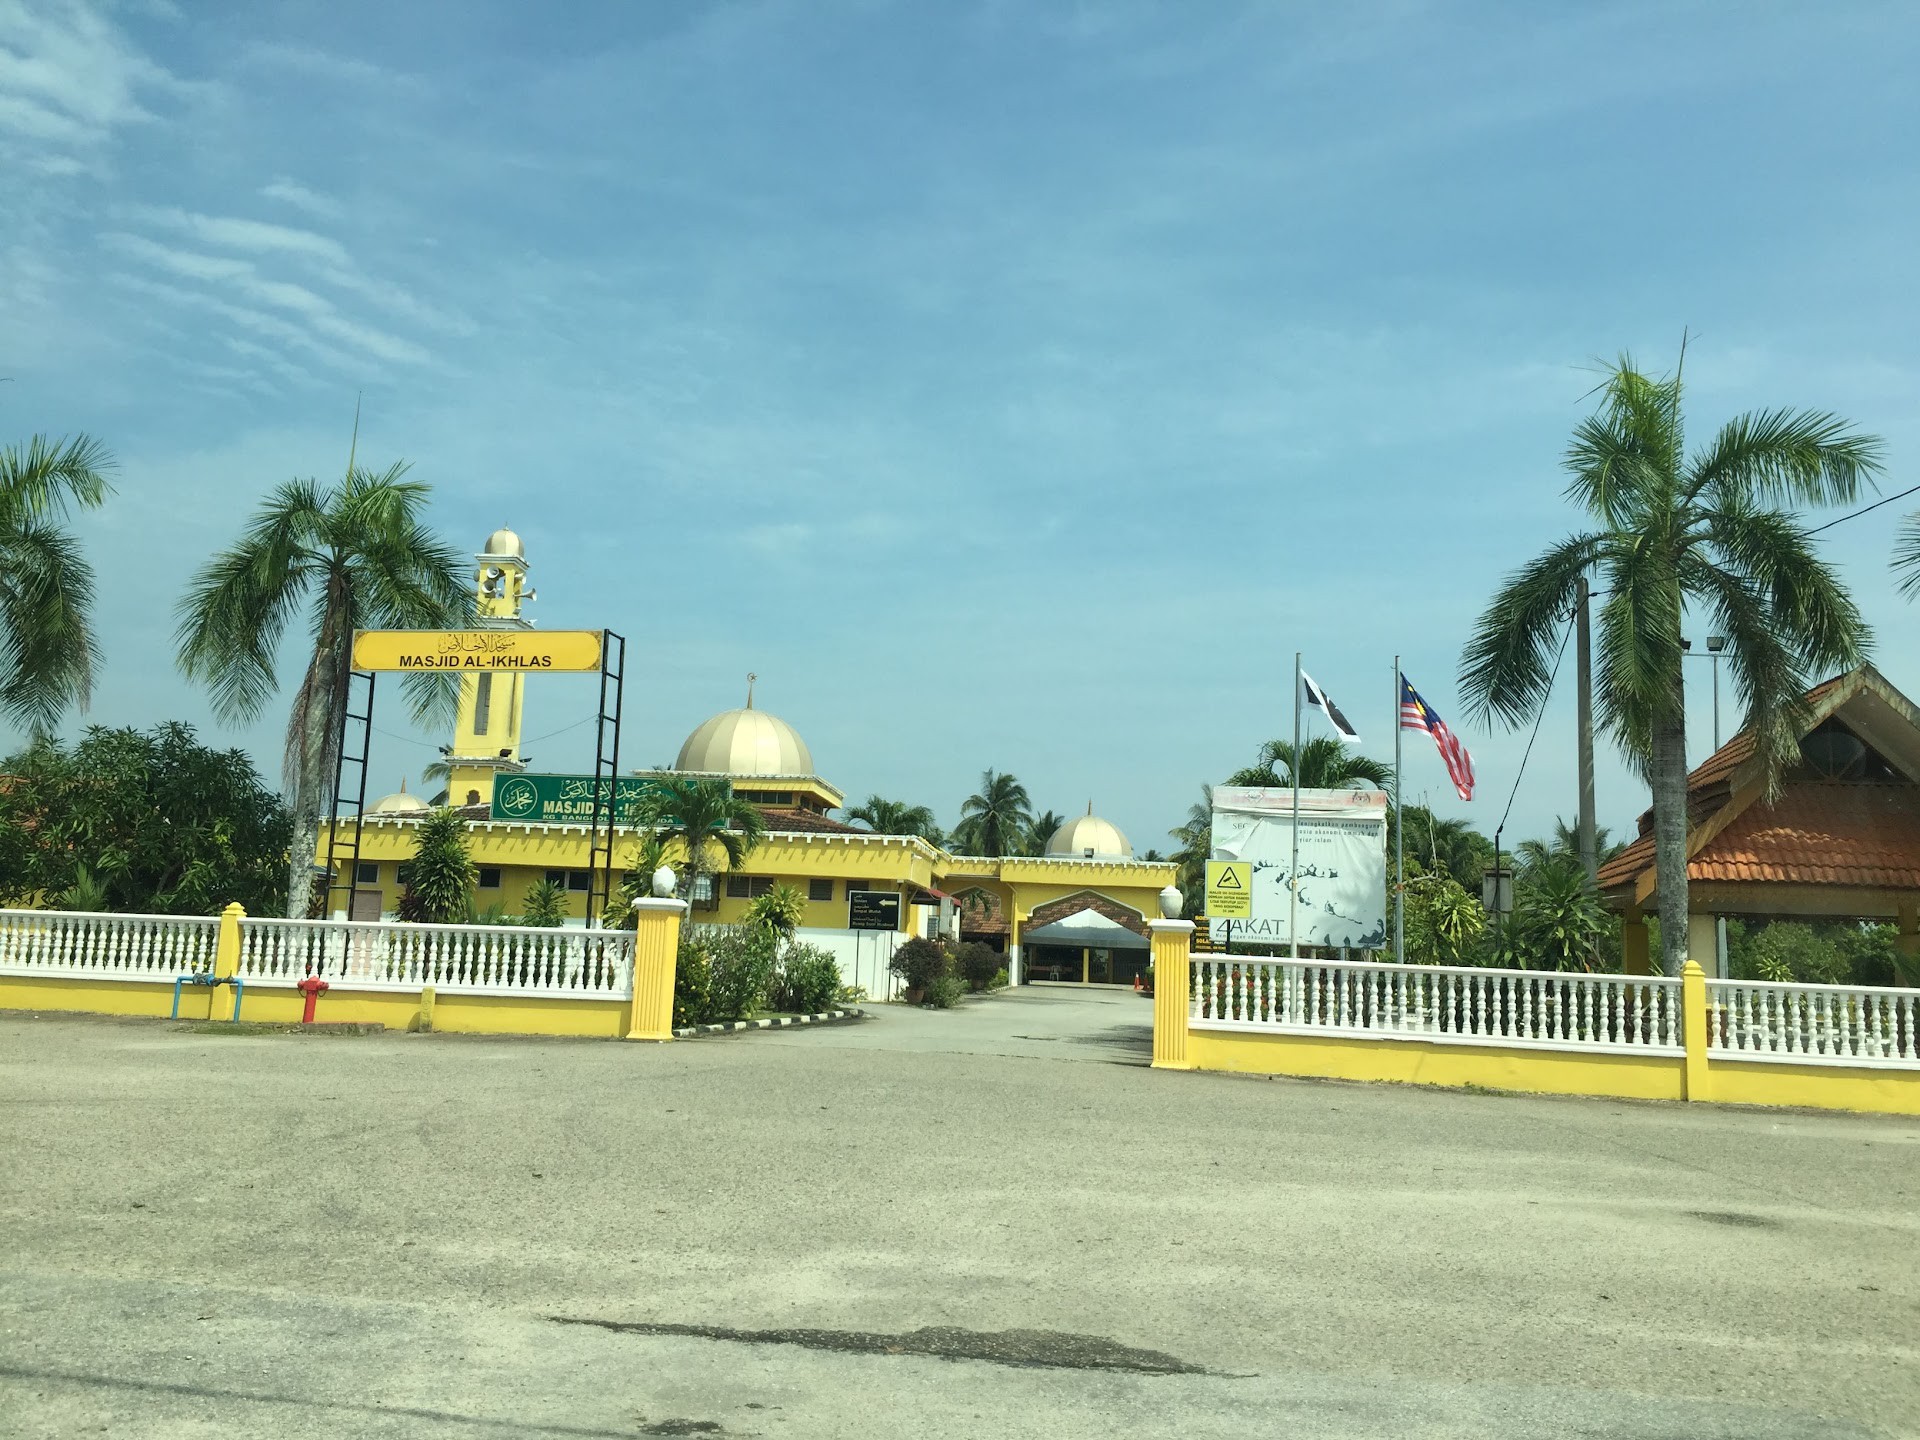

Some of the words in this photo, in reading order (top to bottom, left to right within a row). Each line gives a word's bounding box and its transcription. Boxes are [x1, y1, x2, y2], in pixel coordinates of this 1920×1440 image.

[399, 655, 460, 667] MASJID
[464, 655, 552, 667] AL-IKHLAS
[543, 800, 594, 815] MASJID
